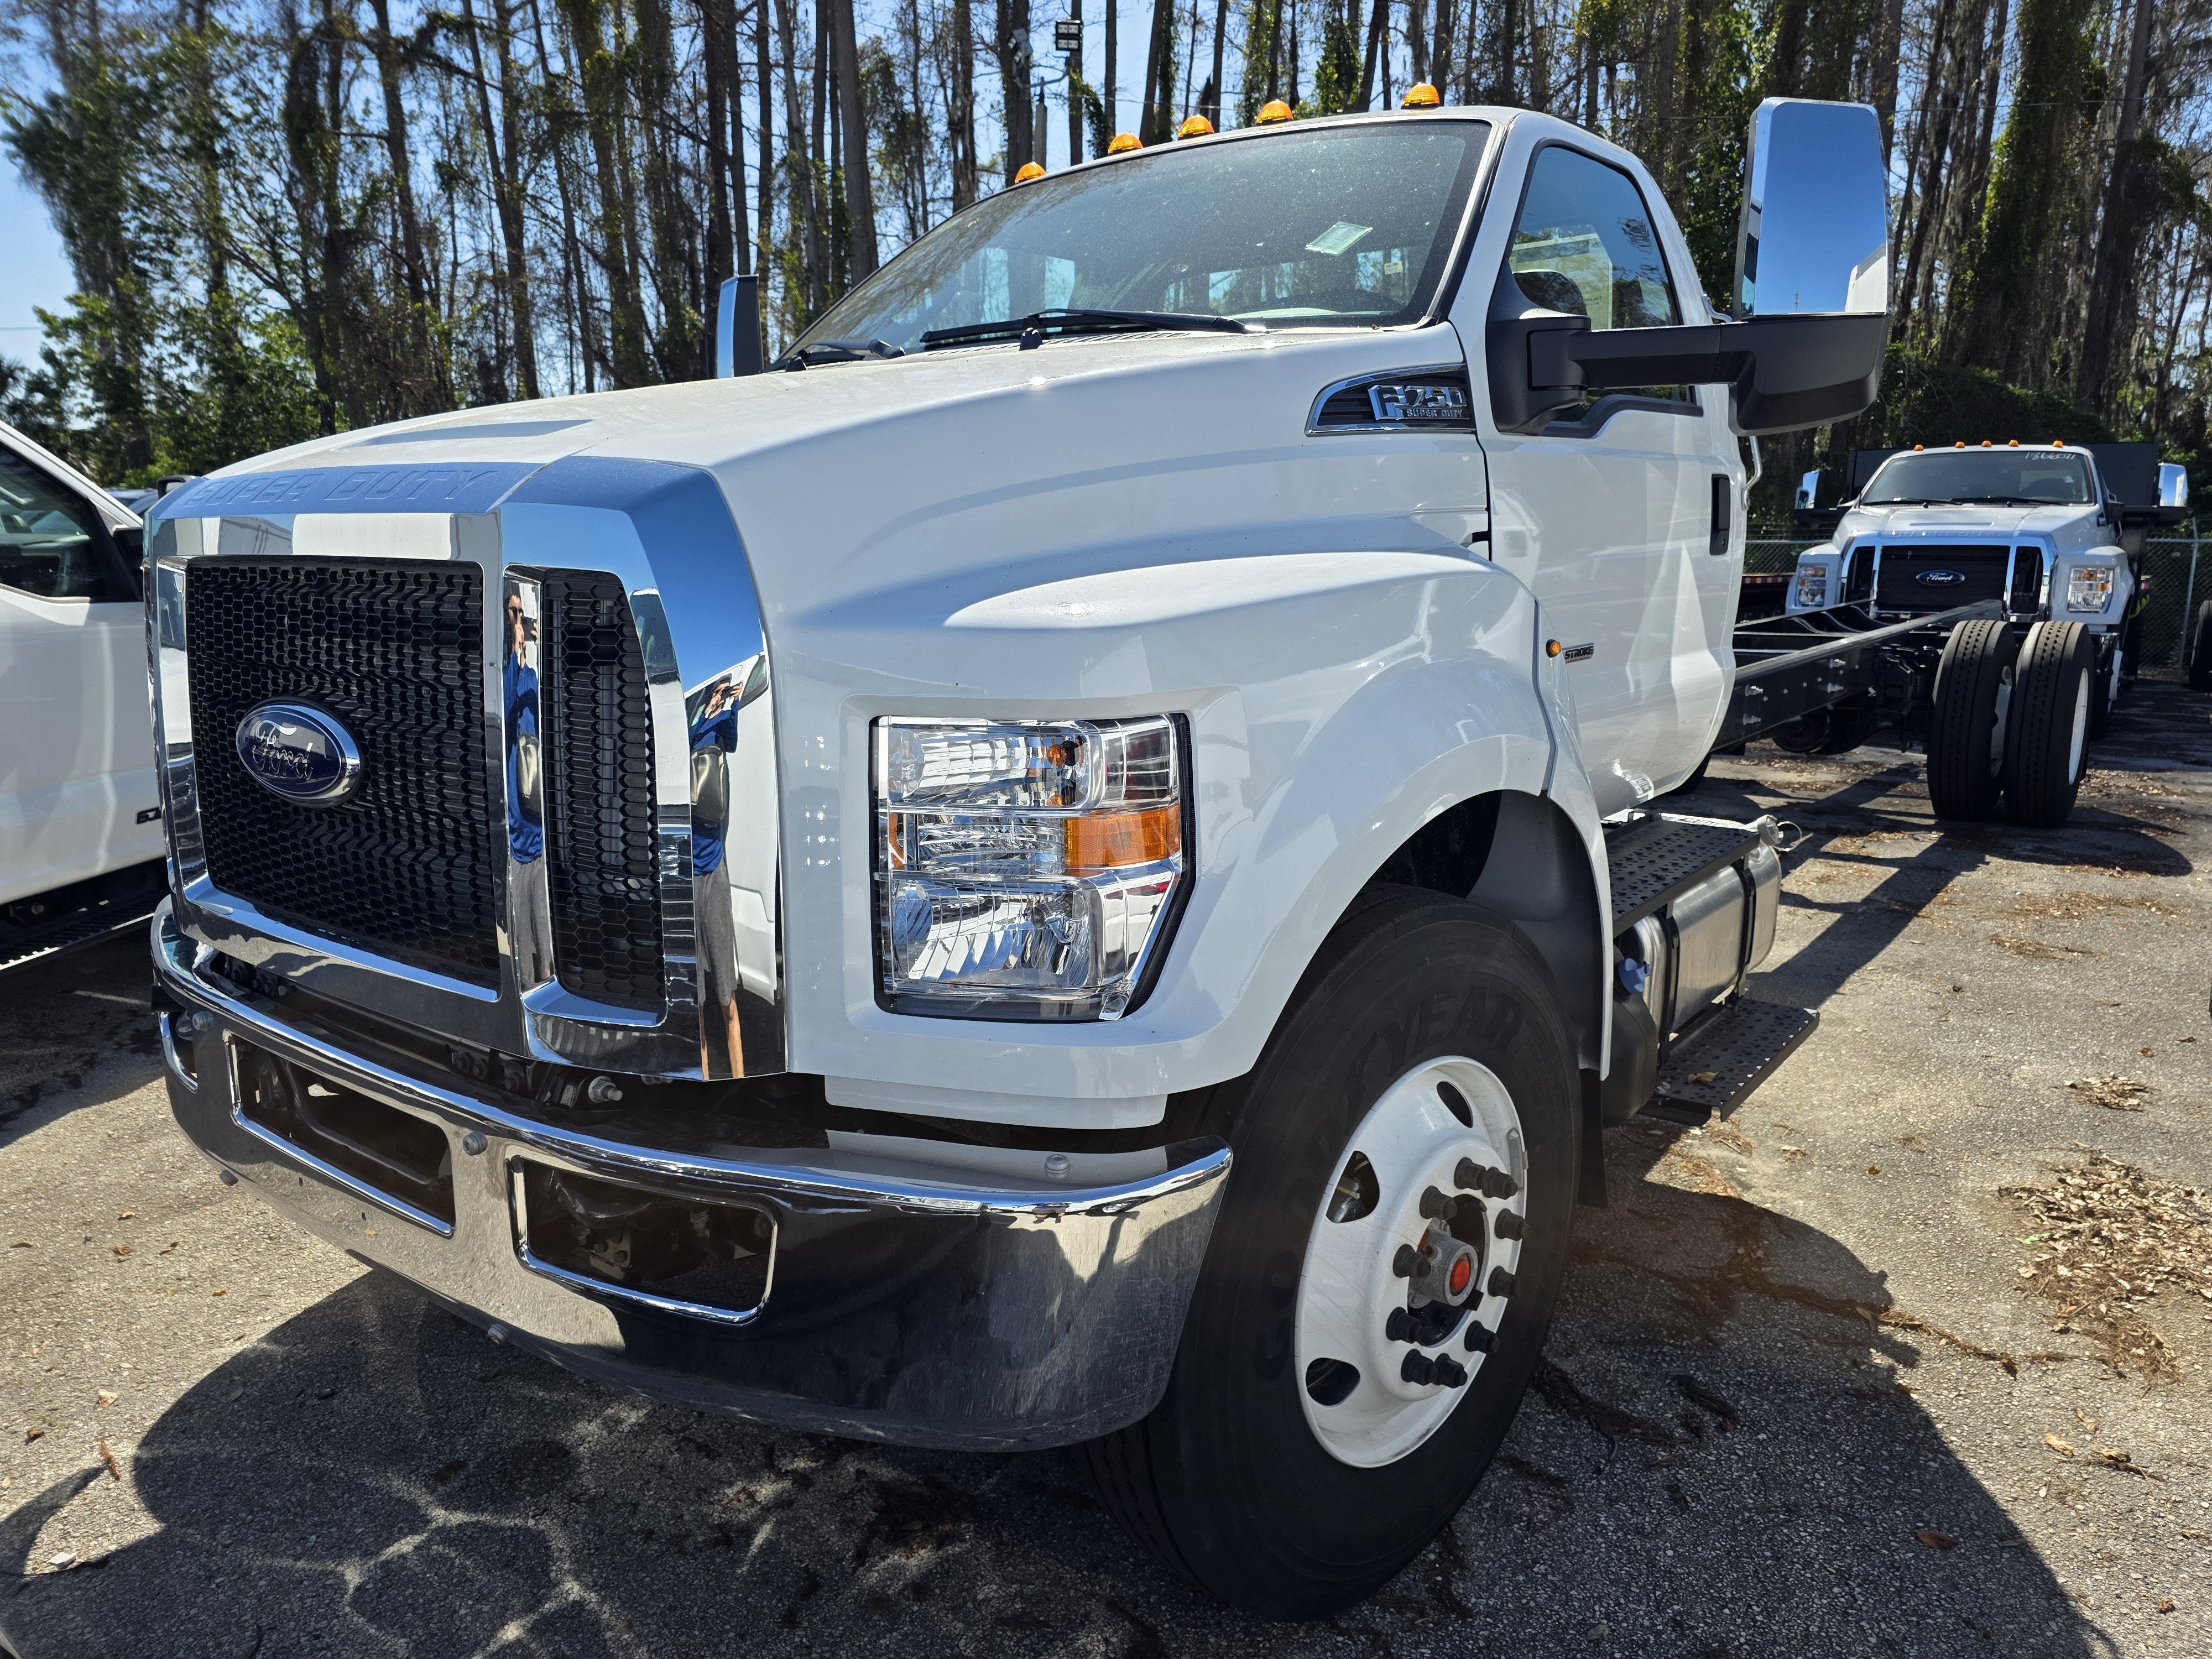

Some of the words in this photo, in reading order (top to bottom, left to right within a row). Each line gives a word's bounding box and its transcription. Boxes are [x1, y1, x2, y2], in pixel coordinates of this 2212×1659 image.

[1406, 408, 1437, 418] SUPER
[1441, 409, 1463, 418] DUTY
[183, 473, 326, 508] SUPER
[324, 470, 498, 502] DUTY
[1927, 572, 1954, 582] Ford
[1564, 645, 1594, 660] STROKE
[252, 719, 314, 780] Ford
